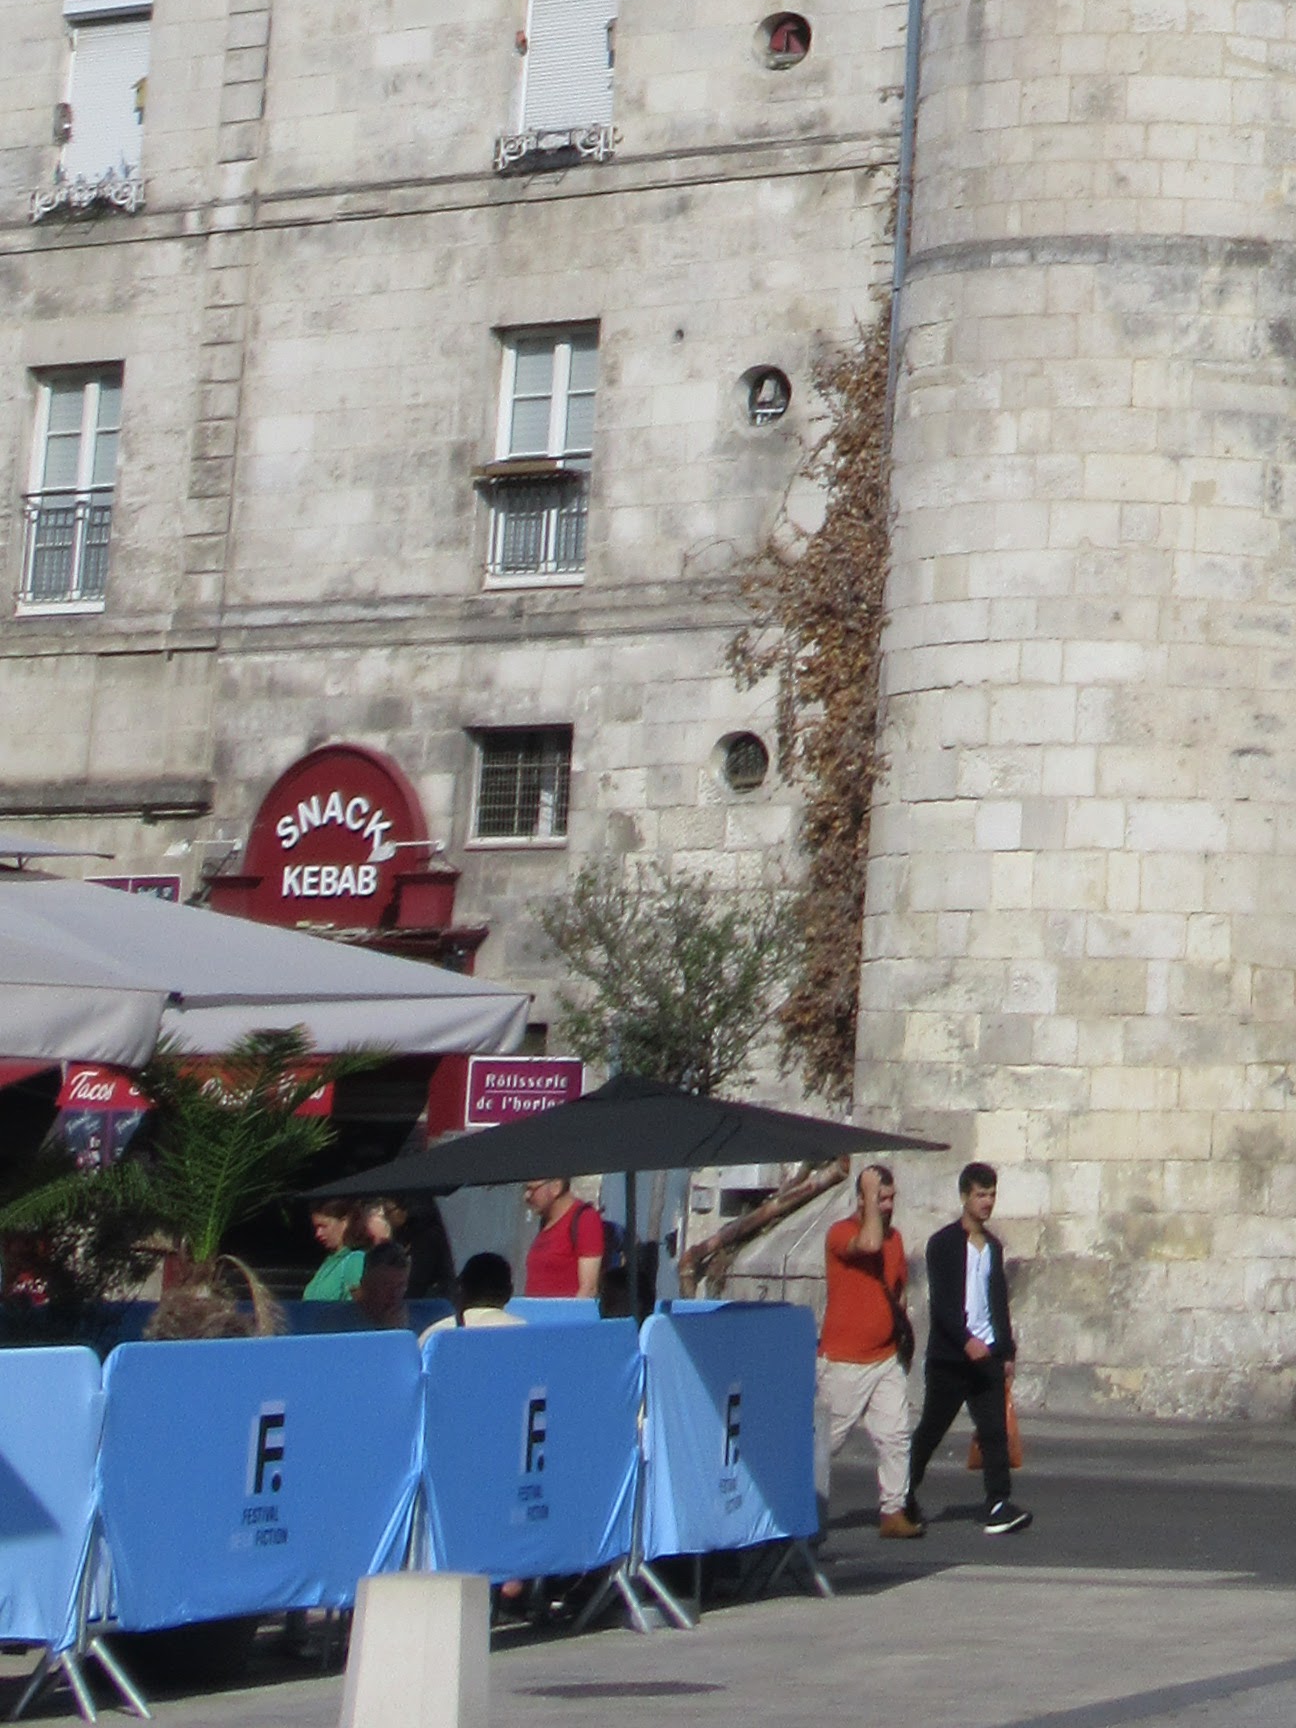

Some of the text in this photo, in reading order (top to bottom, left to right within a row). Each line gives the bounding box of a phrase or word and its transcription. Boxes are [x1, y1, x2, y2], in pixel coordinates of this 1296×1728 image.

[276, 791, 393, 851] SNACK
[282, 864, 378, 897] KEBAB
[68, 1070, 116, 1102] Tacos
[476, 1096, 565, 1112] de l'horlo
